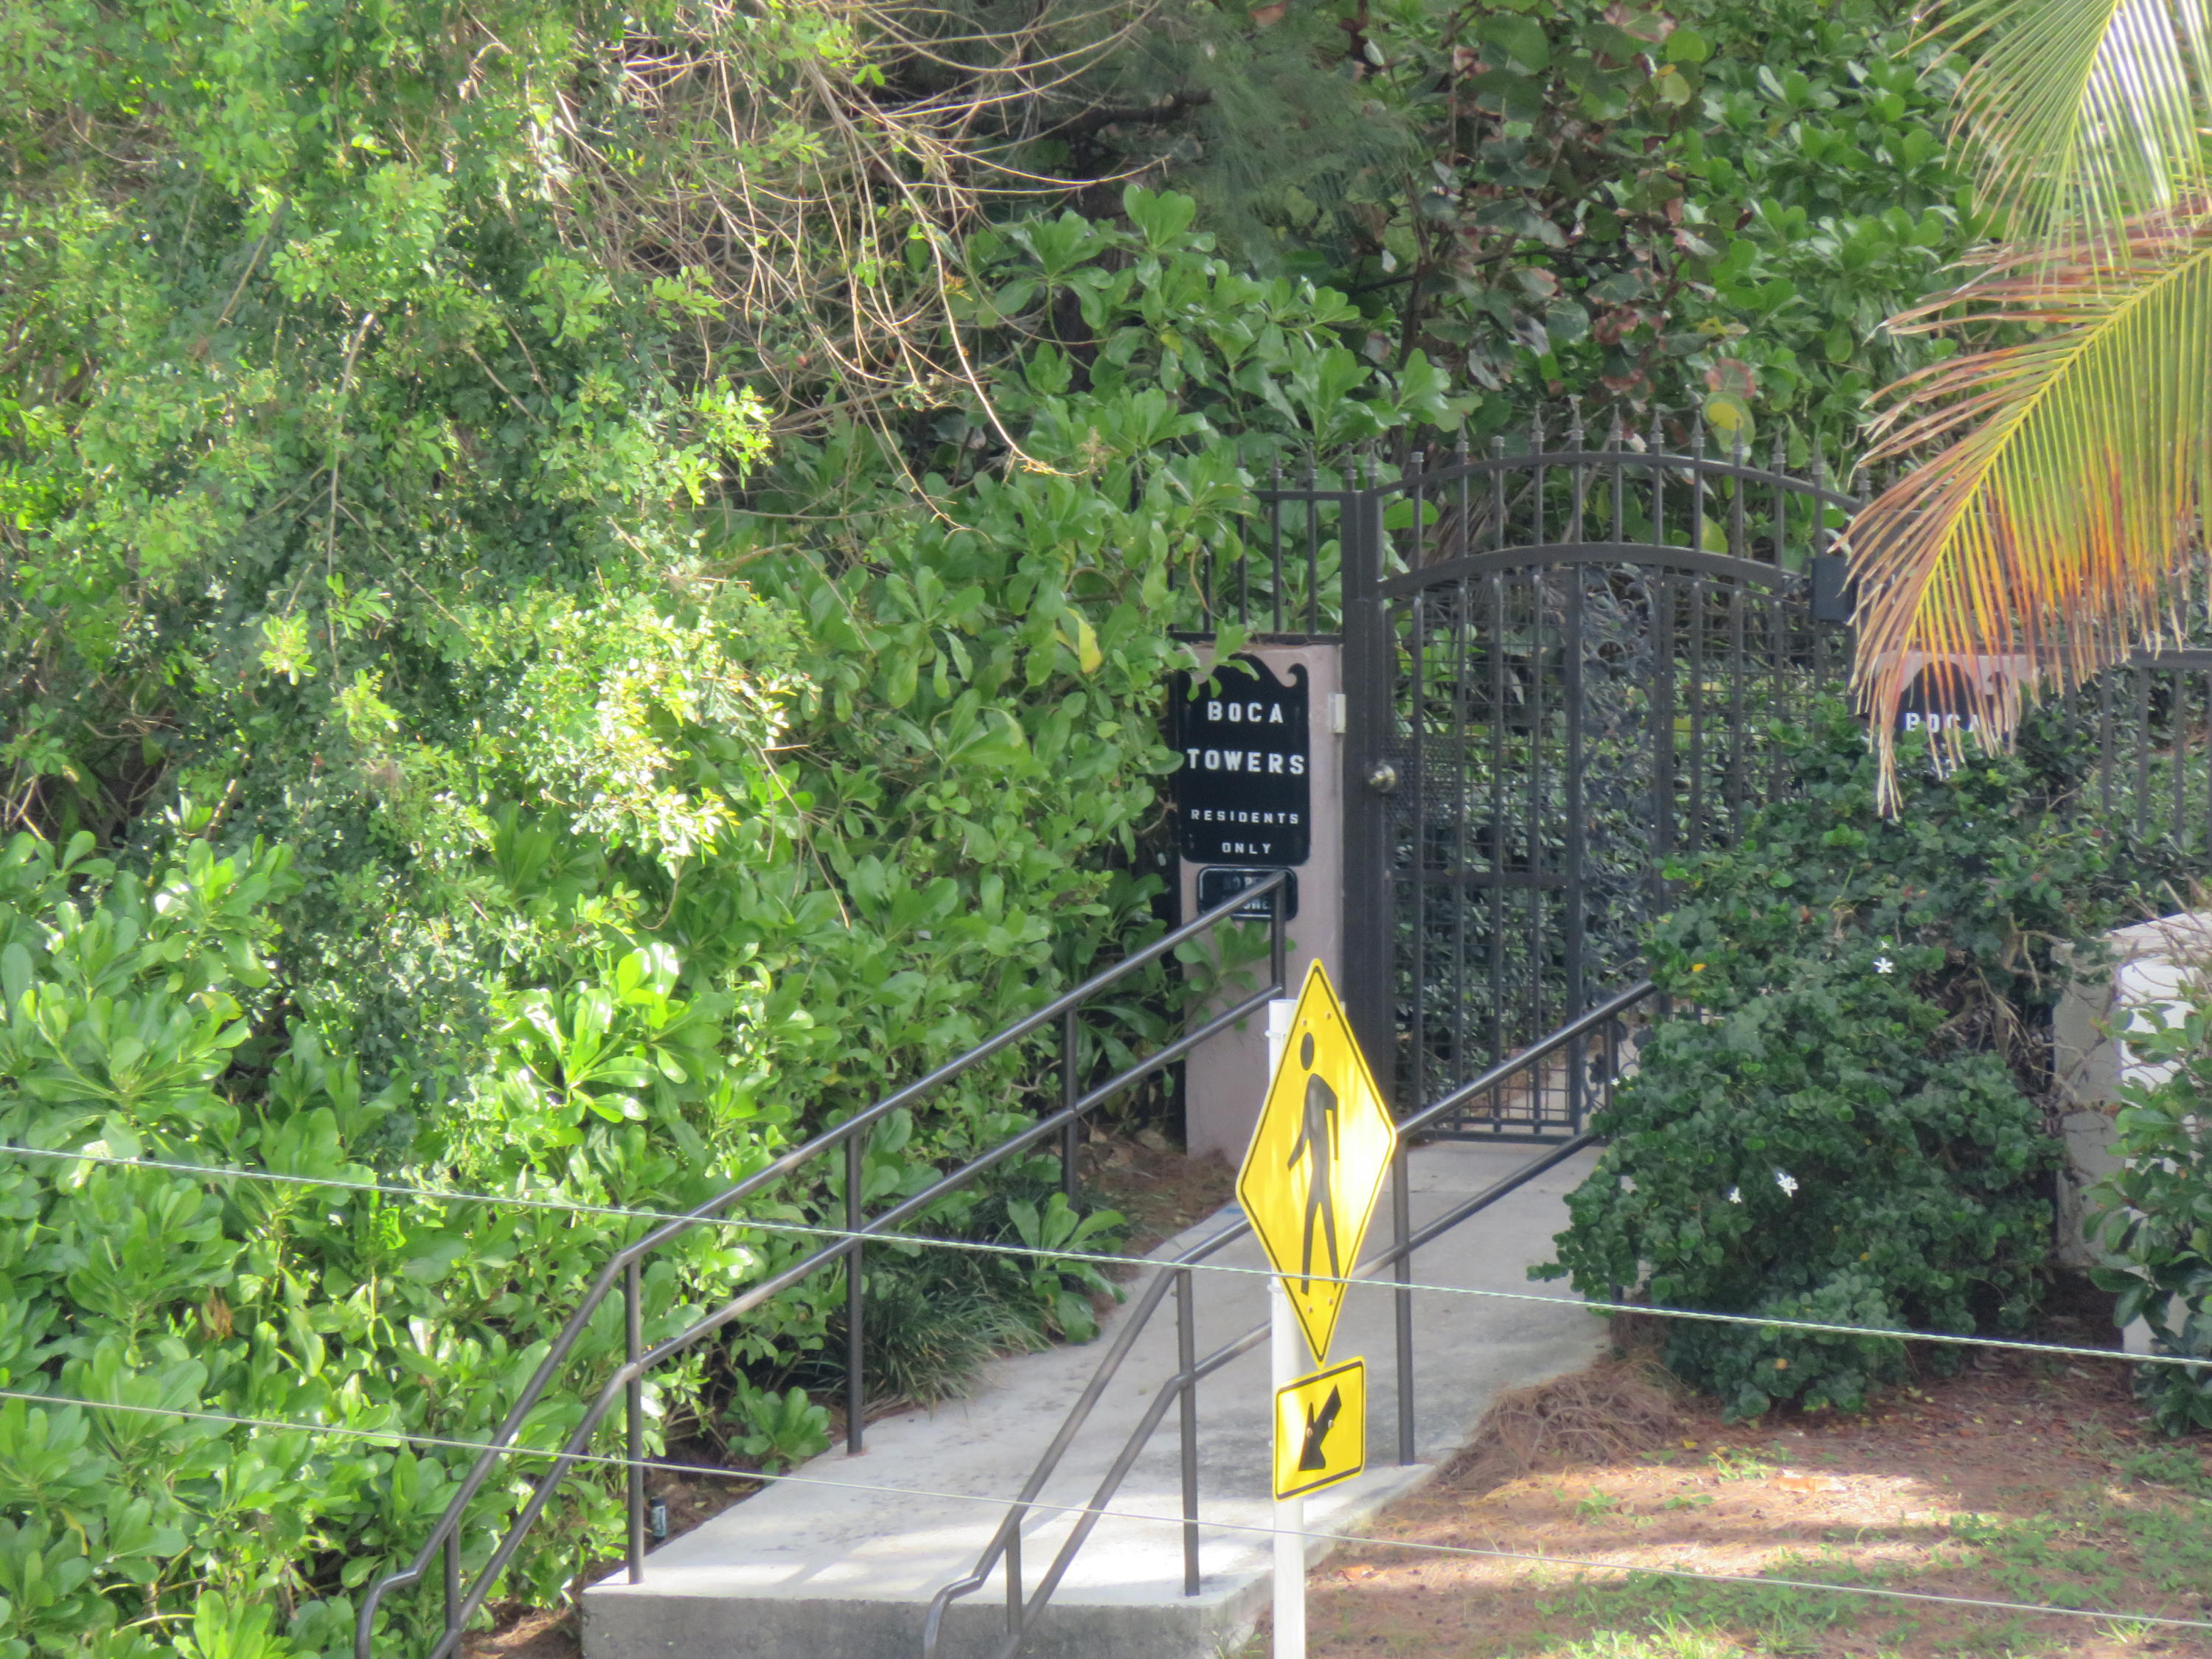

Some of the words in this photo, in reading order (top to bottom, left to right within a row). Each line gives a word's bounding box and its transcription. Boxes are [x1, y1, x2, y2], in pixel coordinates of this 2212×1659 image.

[1207, 700, 1284, 724] BOCA
[1186, 748, 1305, 775] TOWERS
[1190, 809, 1299, 824] RESIDENTS
[1221, 841, 1272, 855] ONLY
